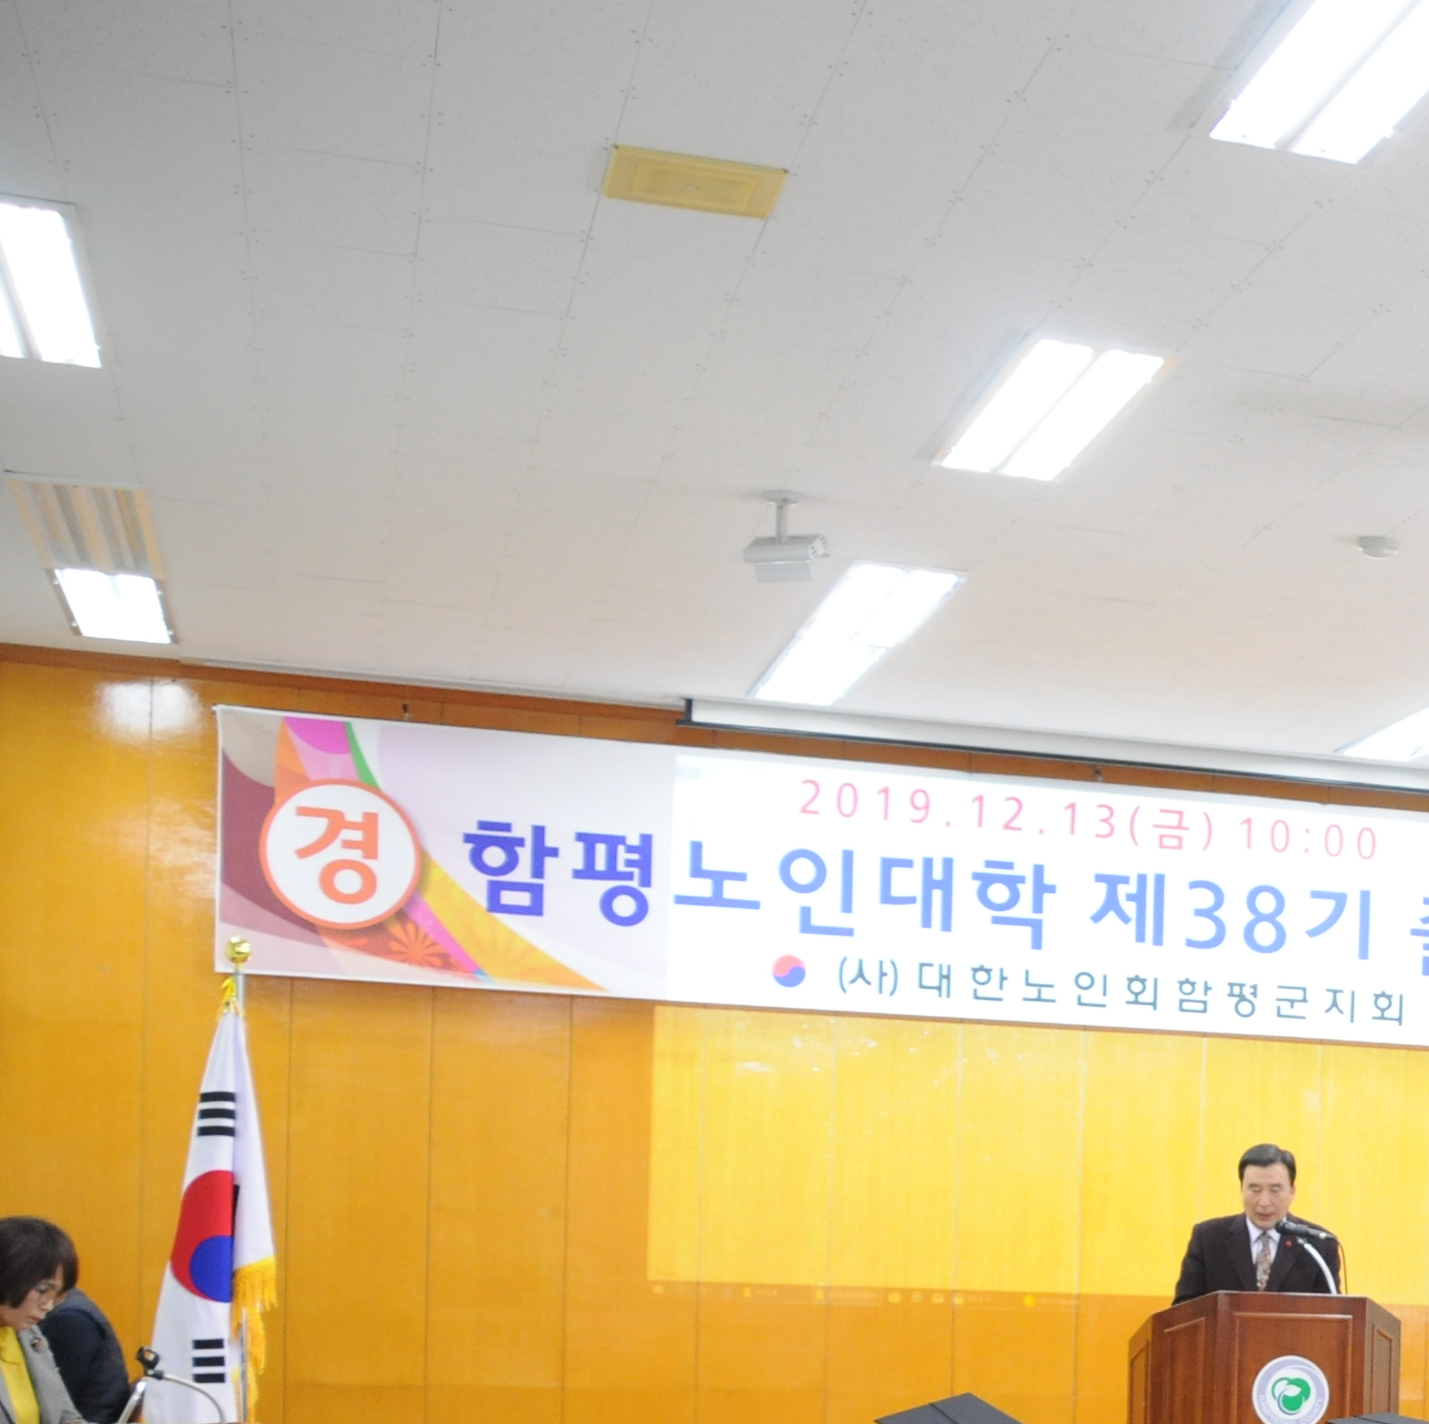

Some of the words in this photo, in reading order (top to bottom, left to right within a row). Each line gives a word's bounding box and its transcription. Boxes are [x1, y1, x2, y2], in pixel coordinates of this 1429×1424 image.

[294, 805, 380, 904] 경
[799, 779, 1213, 852] 2019.12.13(금)
[1239, 816, 1377, 861] 10:00
[462, 819, 1056, 951] 함평노인대학
[1090, 872, 1372, 960] 제38기
